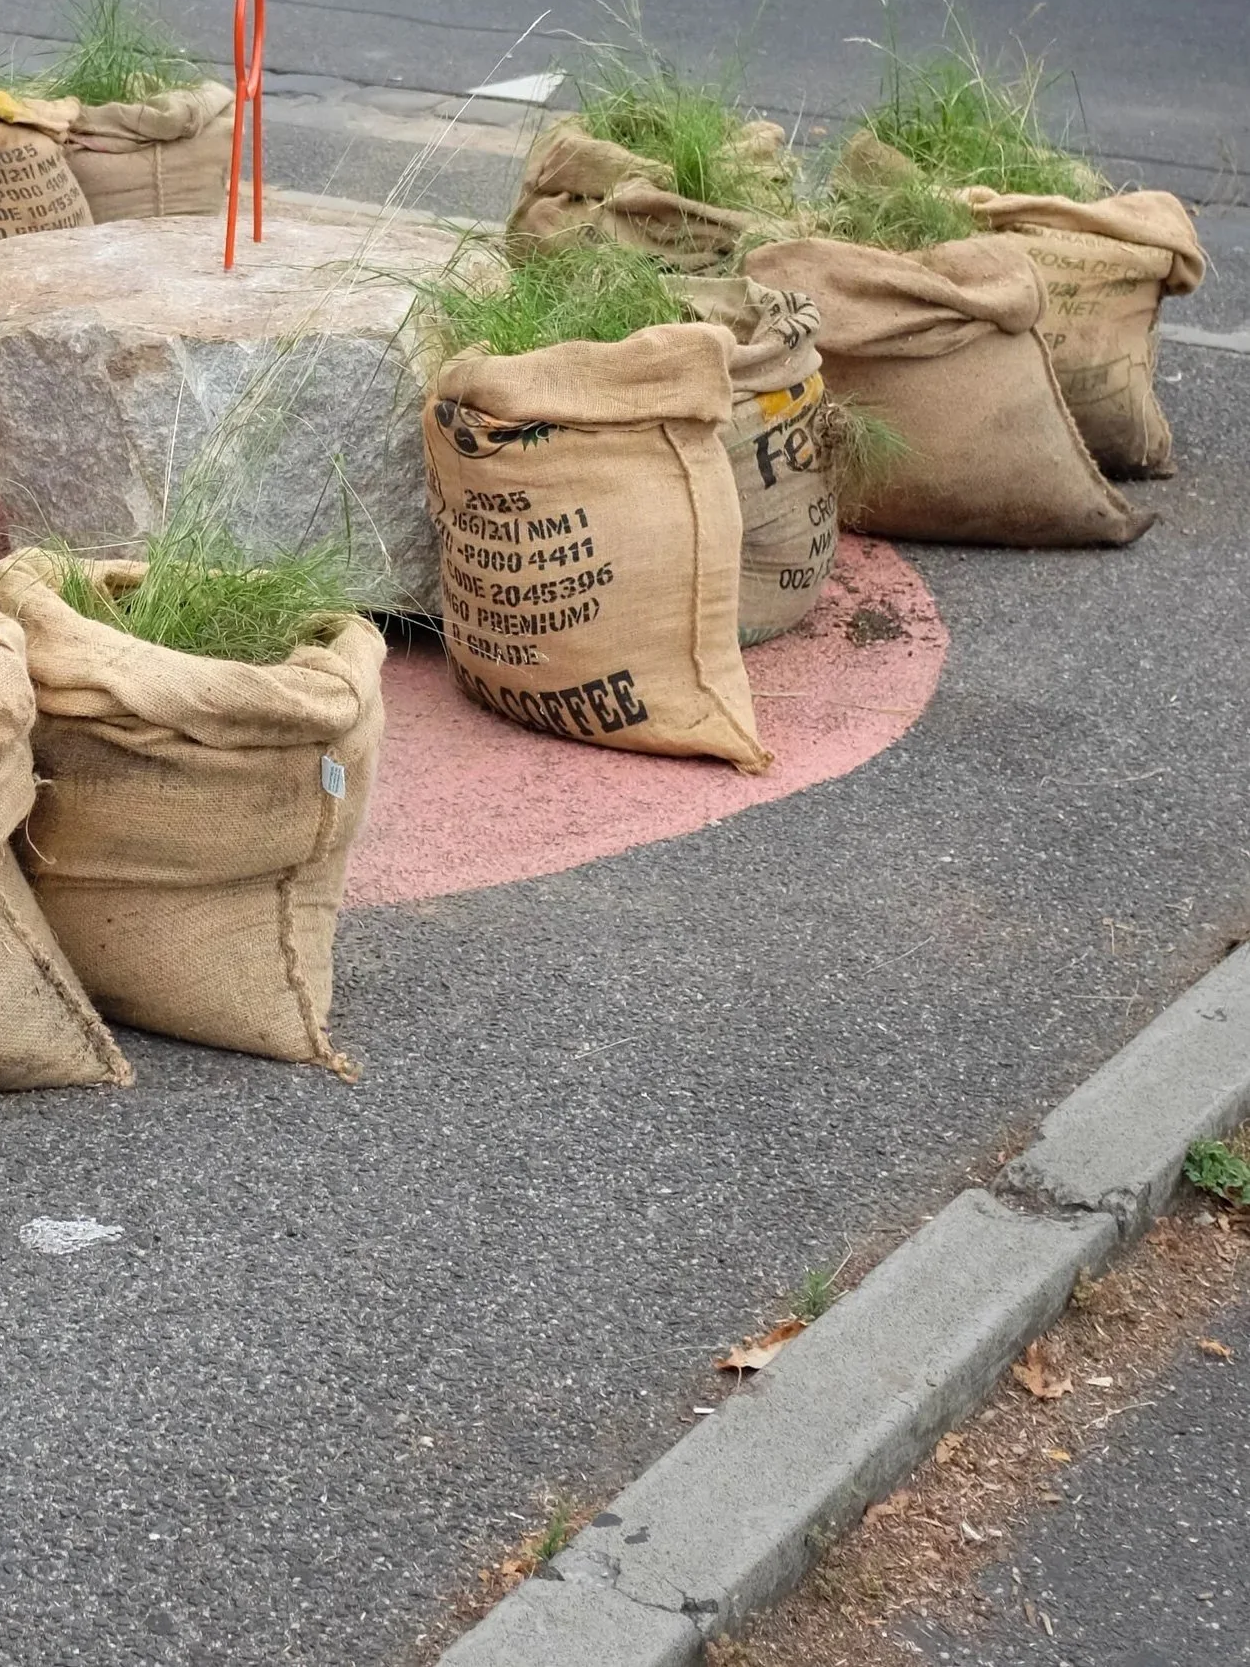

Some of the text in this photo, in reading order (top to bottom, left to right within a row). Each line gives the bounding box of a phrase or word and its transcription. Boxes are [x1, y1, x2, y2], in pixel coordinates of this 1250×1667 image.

[1027, 247, 1086, 273] ROSA
[1091, 260, 1121, 276] DE
[464, 489, 532, 514] 2025
[527, 537, 595, 571] 4411
[491, 562, 615, 608] 2045396
[467, 634, 540, 666] GRADE
[500, 669, 648, 736] COFFEE
